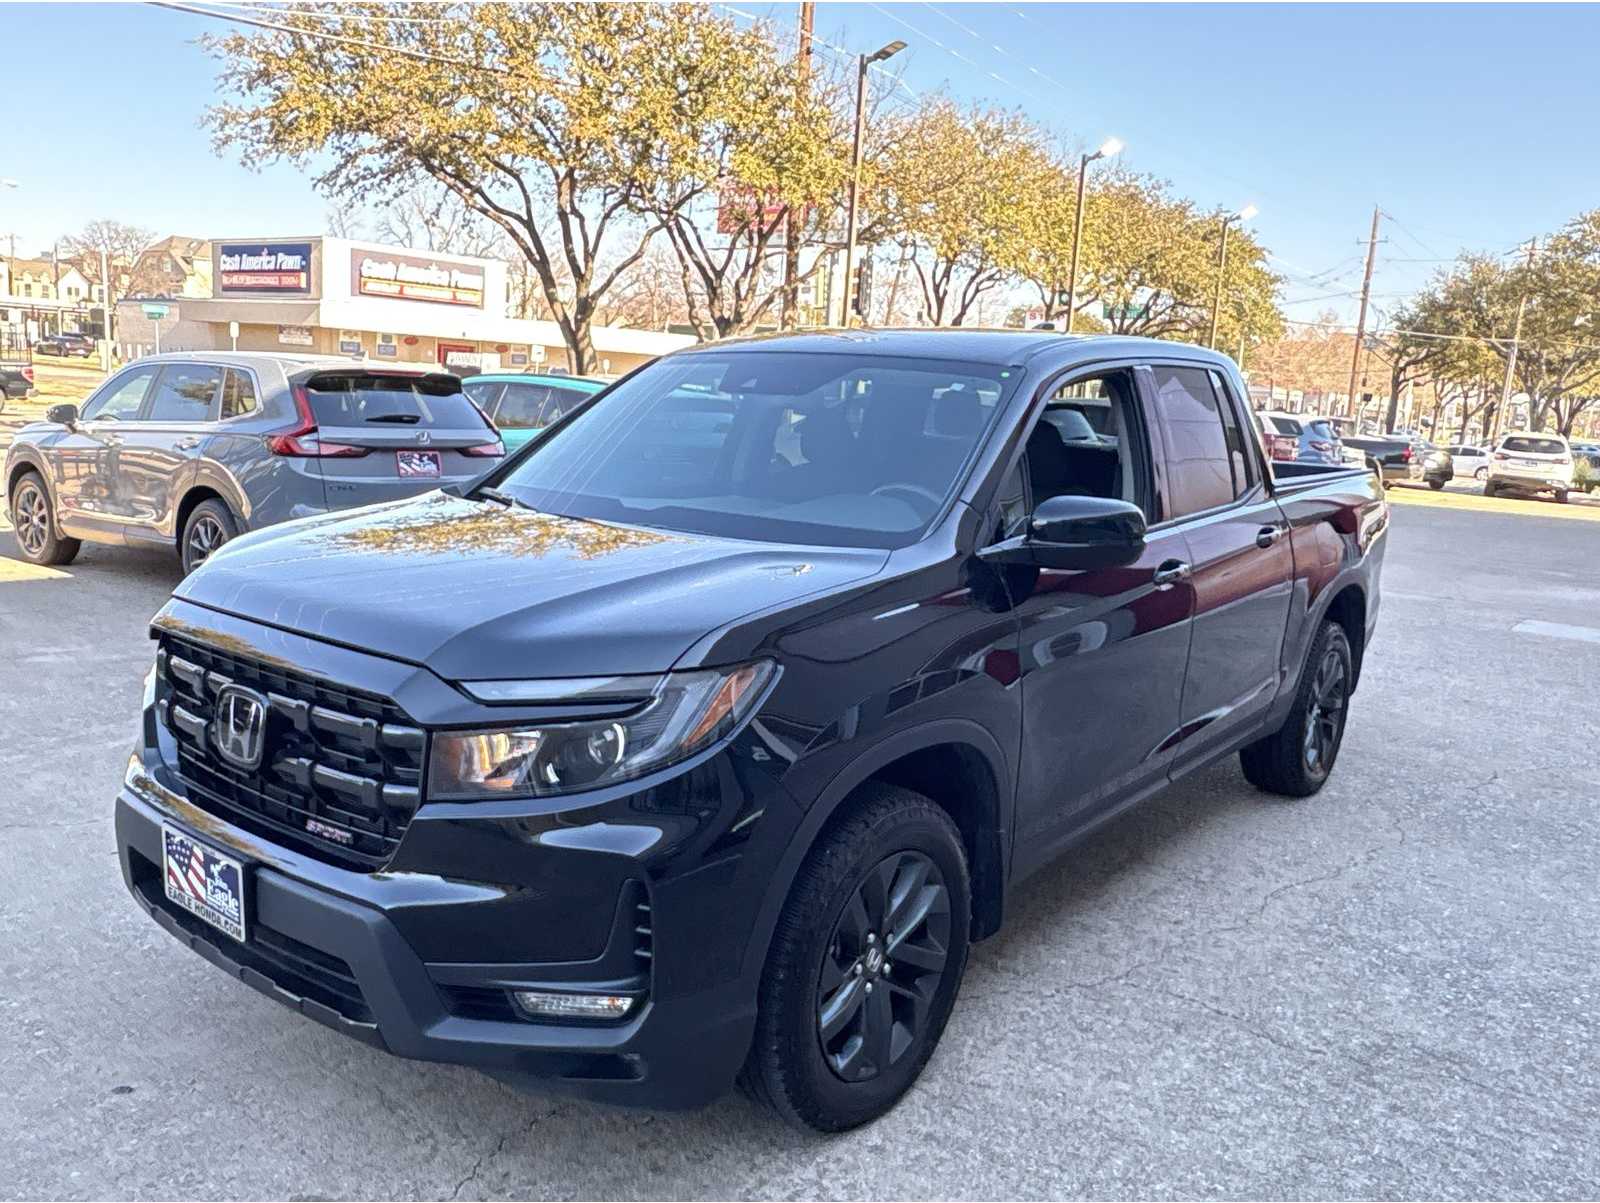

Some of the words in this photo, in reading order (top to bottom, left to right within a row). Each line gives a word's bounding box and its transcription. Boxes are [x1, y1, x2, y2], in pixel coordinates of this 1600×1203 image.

[220, 254, 240, 271] Cash
[240, 252, 277, 270] America
[276, 252, 302, 270] Pawn
[168, 886, 193, 910] EAGLE
[206, 876, 239, 912] Eagle
